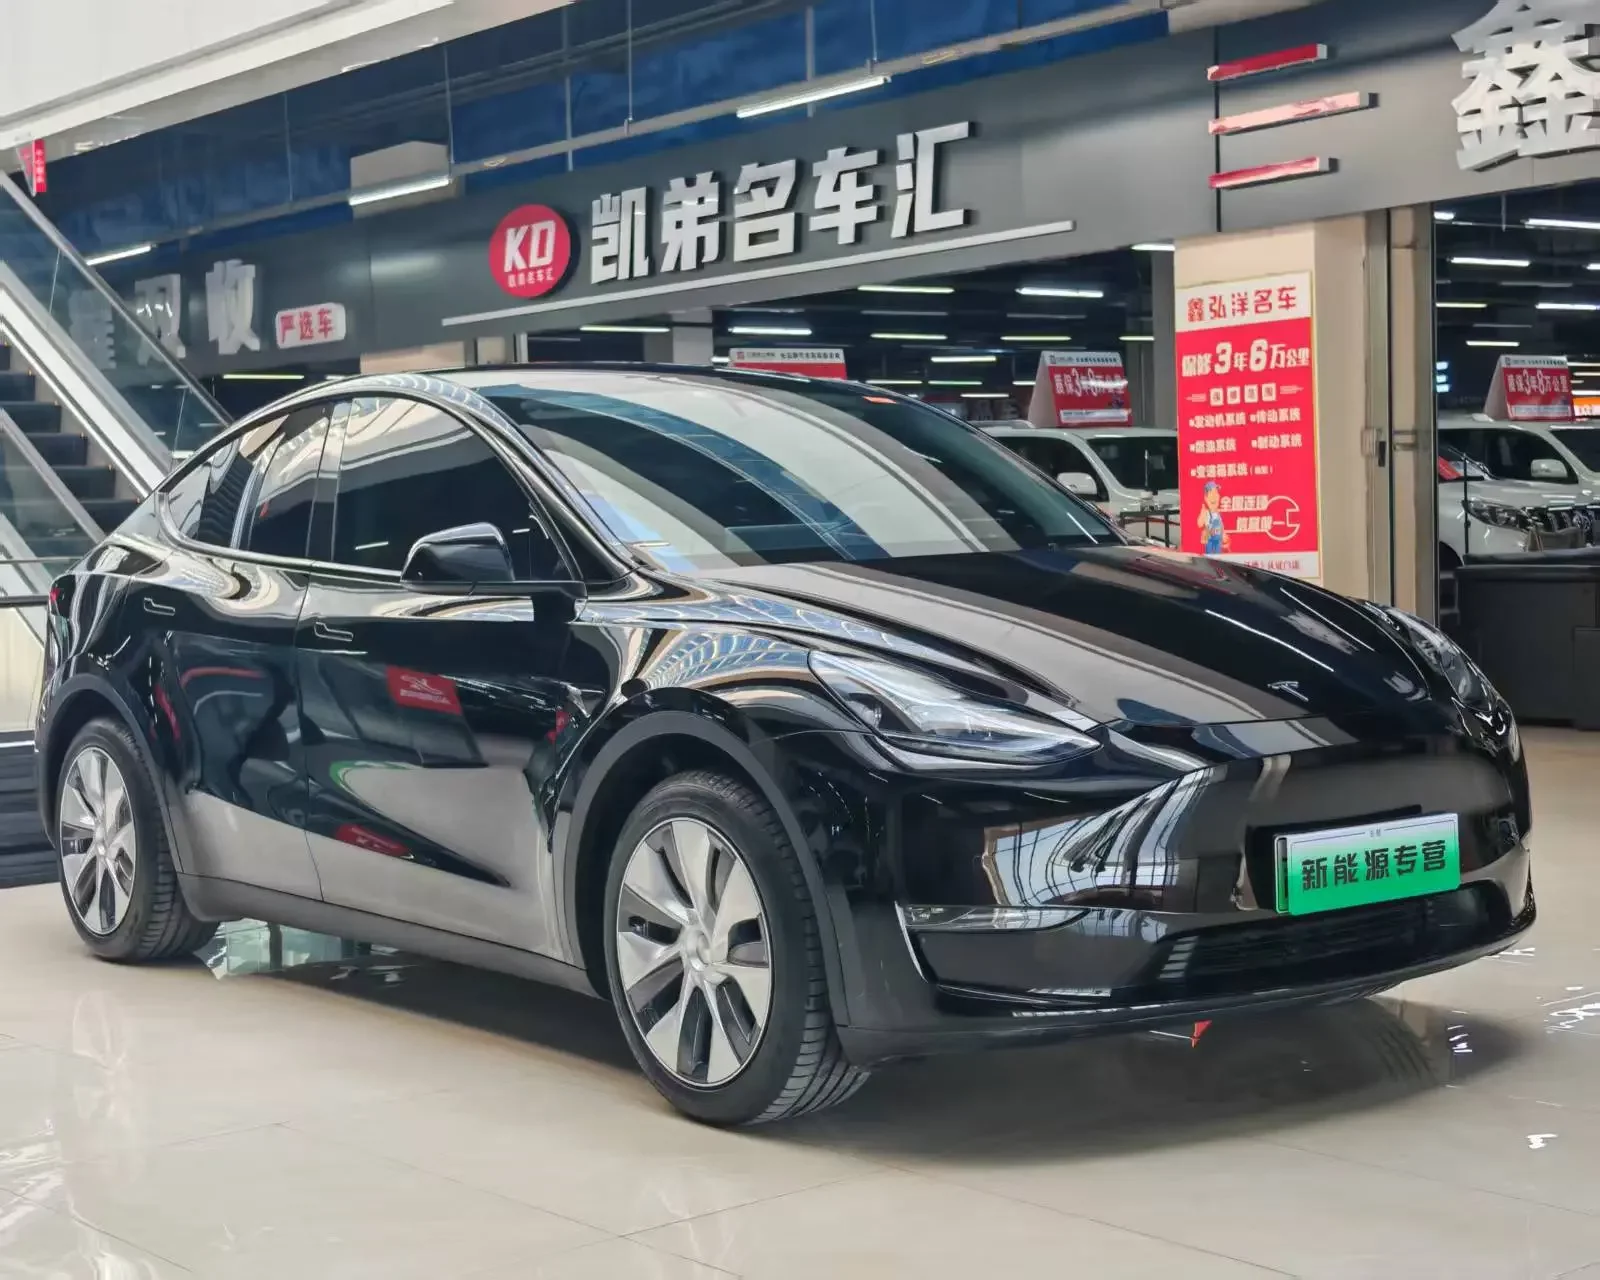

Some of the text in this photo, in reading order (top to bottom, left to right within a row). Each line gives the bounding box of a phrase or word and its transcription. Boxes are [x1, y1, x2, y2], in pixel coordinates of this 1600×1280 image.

[590, 121, 970, 284] 凯弟名车汇
[503, 220, 556, 273] KD
[279, 308, 334, 344] 严选车
[1187, 285, 1297, 323] 鑫弘洋名车
[1181, 338, 1310, 378] 保修3年6万公里
[1302, 840, 1446, 891] 新能源专营
